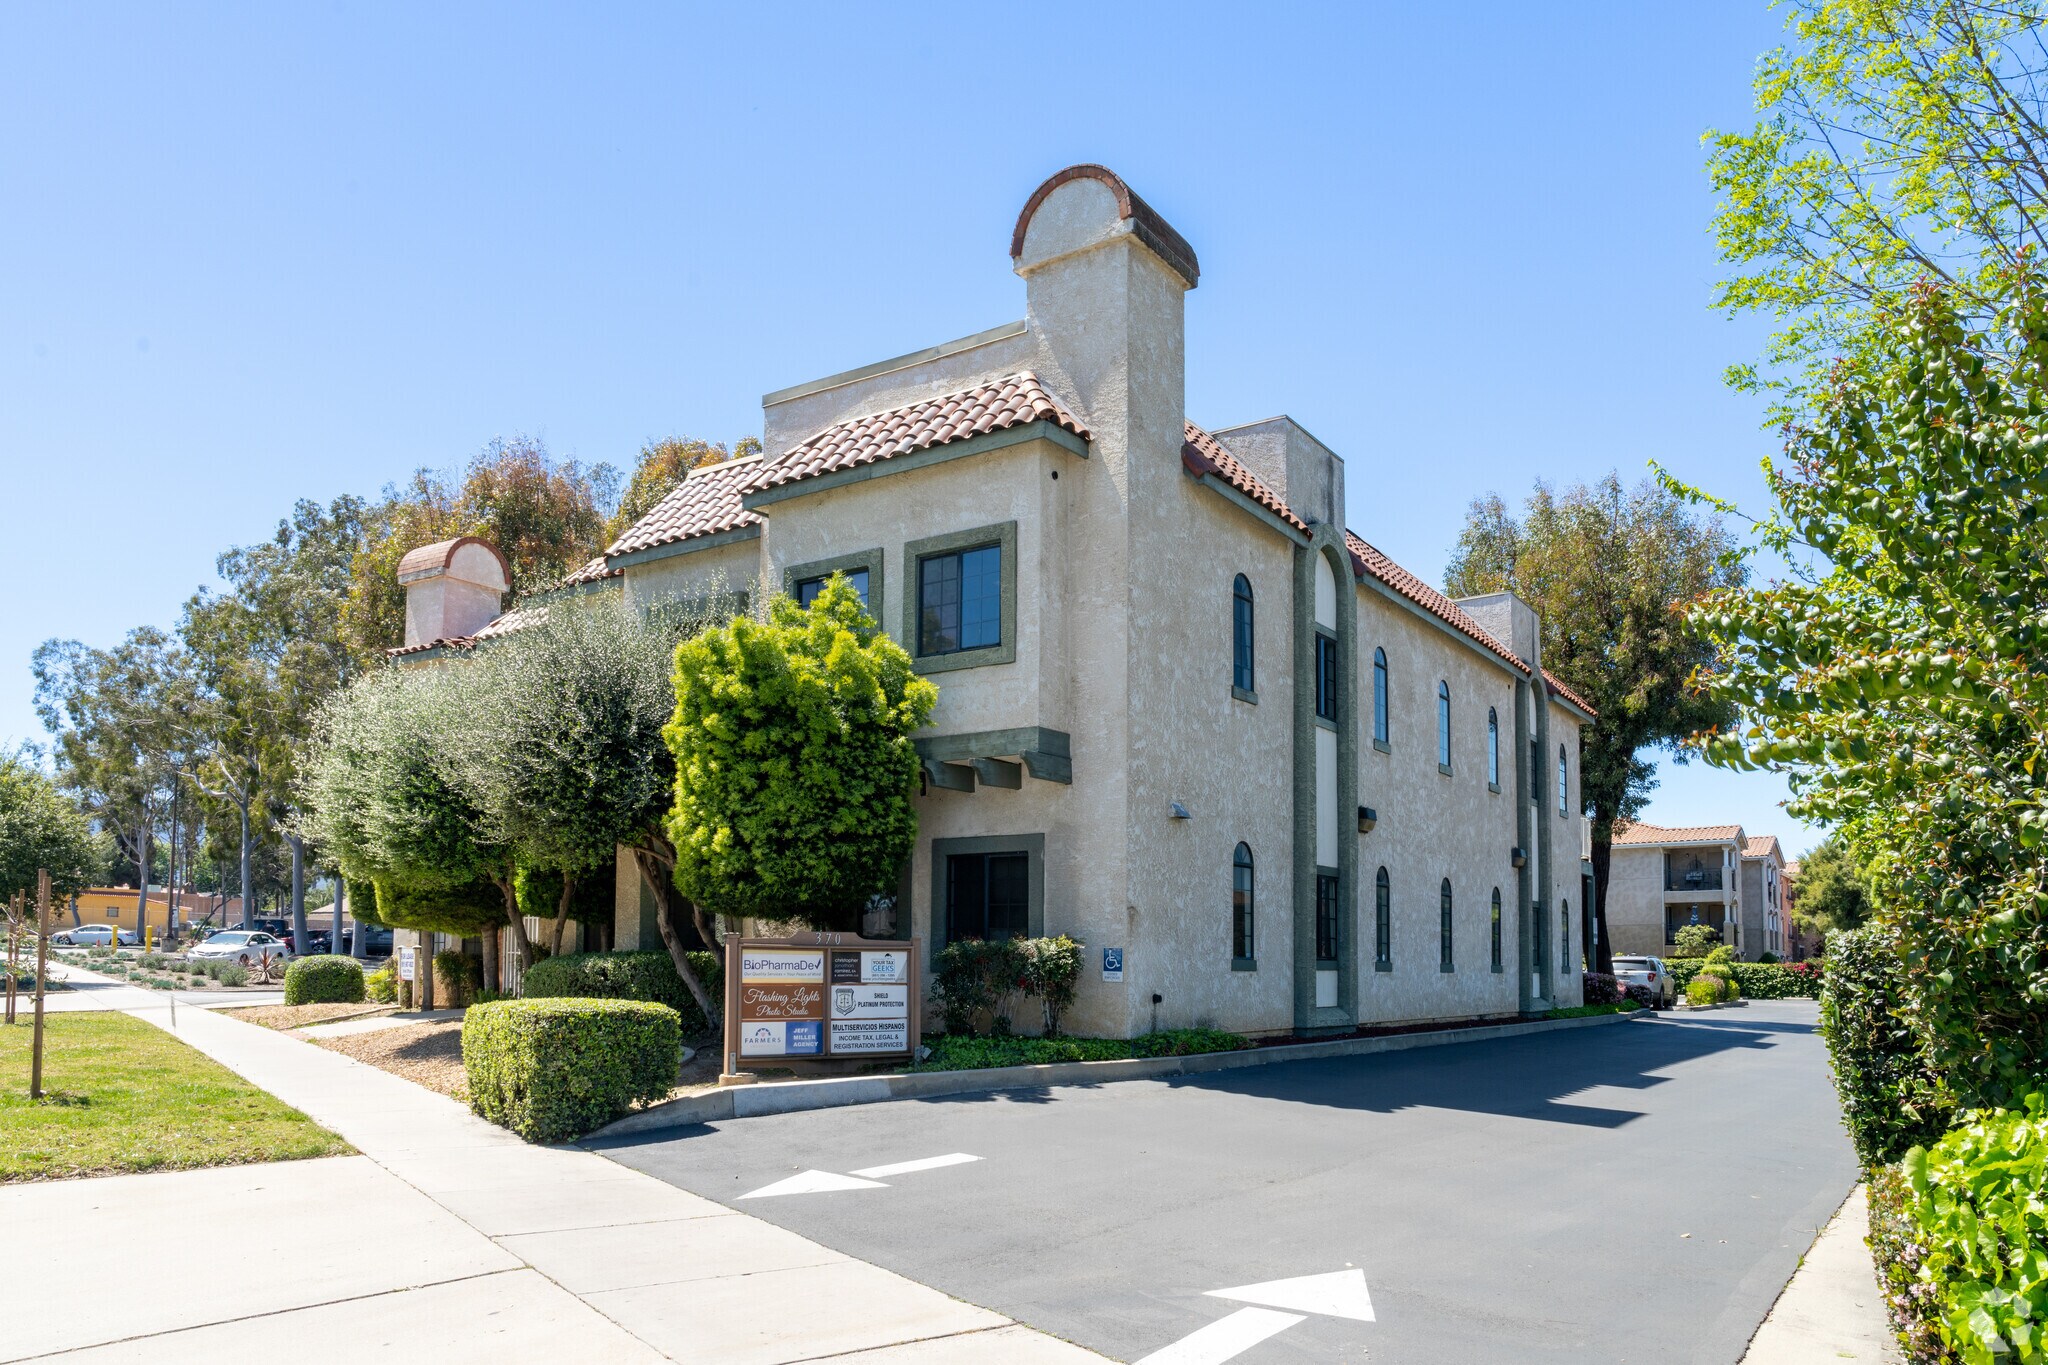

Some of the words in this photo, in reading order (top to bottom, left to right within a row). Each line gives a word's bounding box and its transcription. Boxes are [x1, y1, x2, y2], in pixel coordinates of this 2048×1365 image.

[815, 932, 841, 945] 370
[744, 988, 789, 1006] Flashing
[791, 987, 820, 1006] Lights
[756, 1004, 781, 1016] Photo
[782, 1004, 809, 1016] Studio
[832, 1023, 878, 1031] MULTISERVICIOS
[878, 1022, 905, 1030] HISPANOS
[833, 1042, 876, 1050] REGISTRATION
